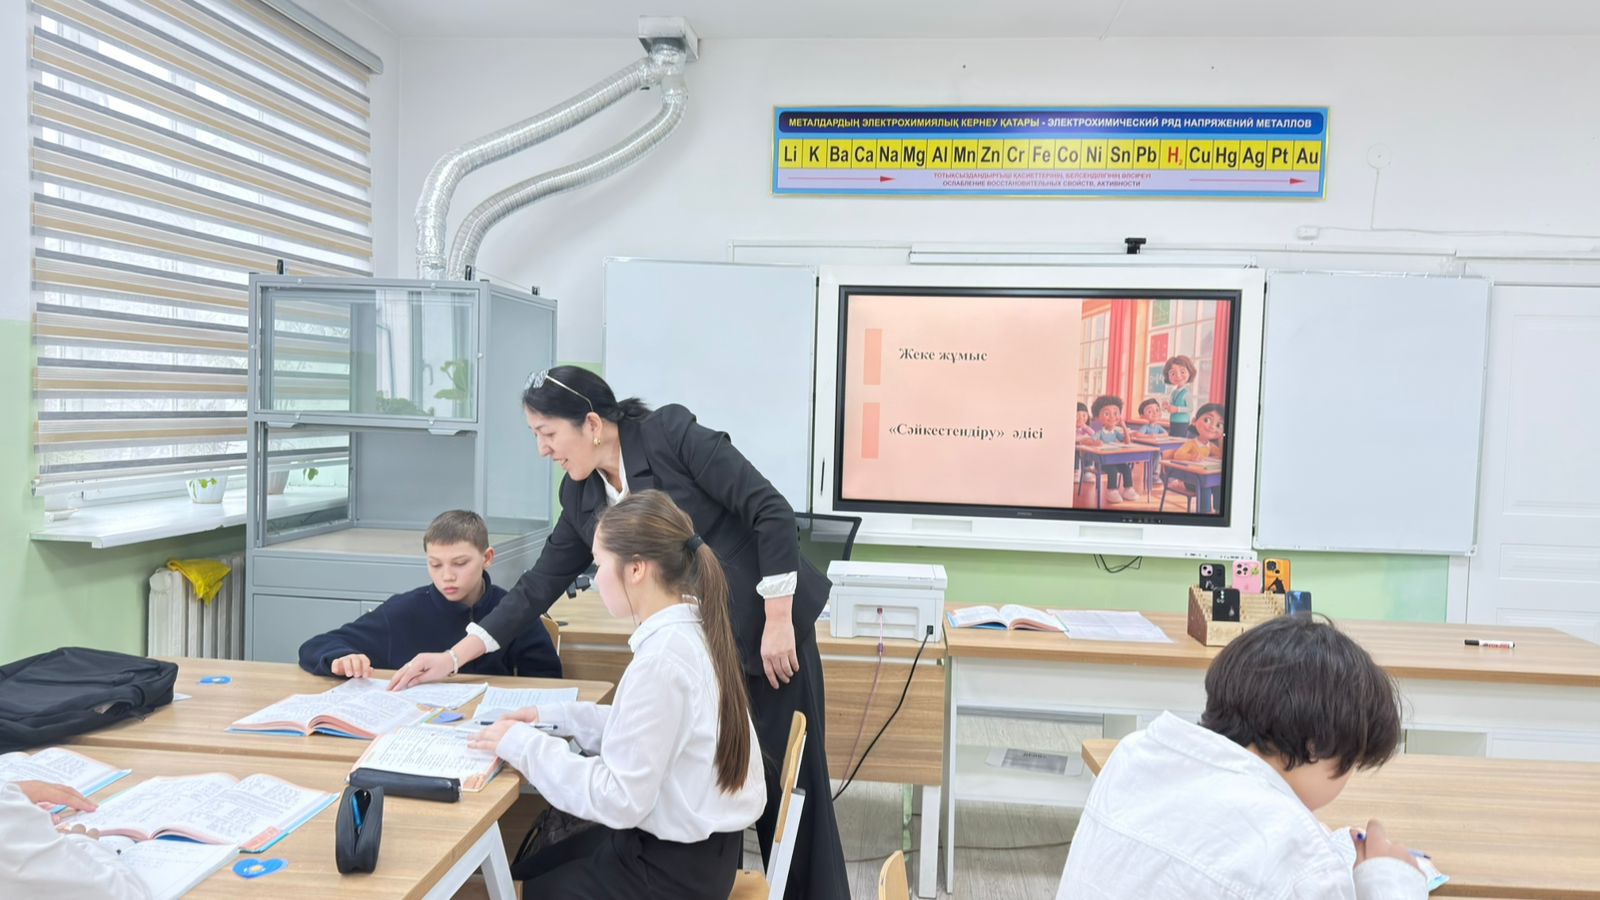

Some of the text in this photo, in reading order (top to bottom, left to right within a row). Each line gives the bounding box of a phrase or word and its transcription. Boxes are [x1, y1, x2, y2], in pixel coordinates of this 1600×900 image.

[788, 118, 861, 129] МЕТАЛДАРДЫҢ
[862, 118, 960, 129] ЭЛЕКТРОХИМИЯЛЫҚ
[961, 118, 998, 128] КЕРНЕУ
[1000, 118, 1040, 129] ҚАТАРЫ
[1047, 117, 1159, 128] ЭЛЕКТРОХИМИЧЕСКИЙ
[1161, 119, 1182, 129] РЯД
[1184, 117, 1254, 128] НАПРЯЖЕНИЙ
[1256, 119, 1312, 128] МЕТАЛЛОВ
[784, 146, 797, 163] Li
[808, 146, 820, 163] K
[829, 146, 849, 163] Ba
[854, 146, 874, 163] Ca
[879, 146, 899, 163] Na
[903, 146, 926, 167] Mg
[932, 146, 948, 163] Al
[953, 146, 976, 163] Mn
[981, 146, 1000, 163] Zn
[1007, 146, 1025, 163] Cr
[1032, 146, 1051, 163] Fe
[1057, 146, 1079, 163] Co
[1086, 146, 1103, 163] Ni
[1110, 146, 1131, 163] Sn
[1136, 146, 1157, 163] Pb
[1189, 146, 1211, 163] Cu
[1216, 146, 1237, 167] Hg
[1242, 146, 1265, 167] Ag
[1271, 146, 1288, 163] Pt
[1296, 146, 1319, 163] Au
[898, 348, 988, 364] Жеке жұмыс
[889, 423, 1043, 440] «Сәйкестендіру» әдісі
